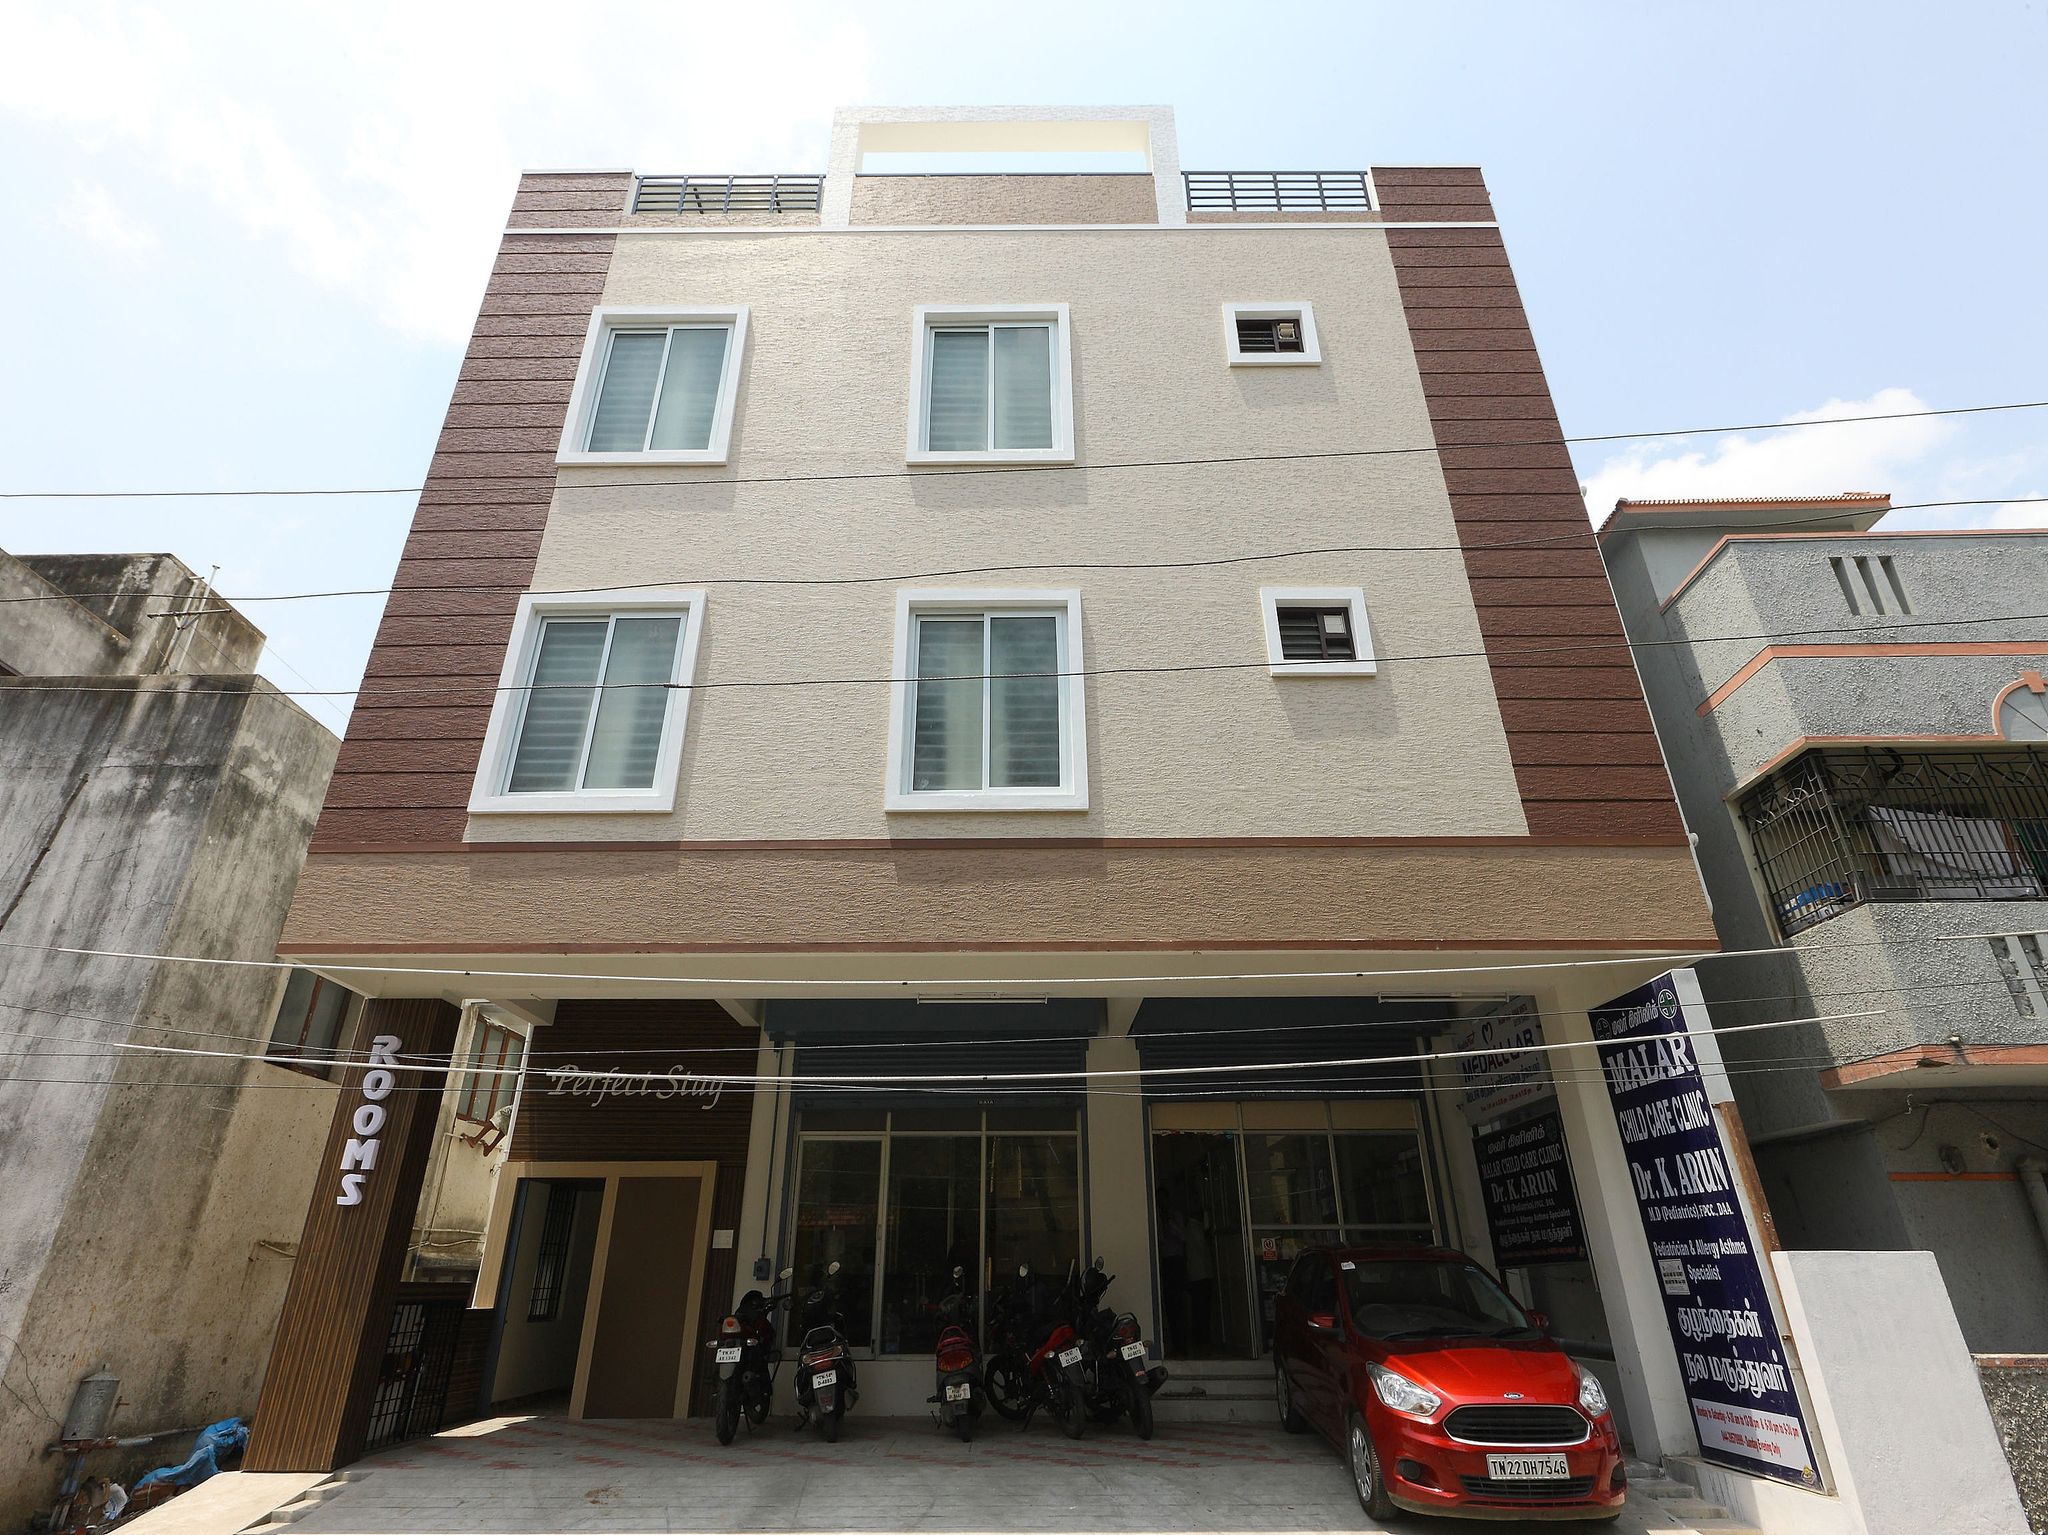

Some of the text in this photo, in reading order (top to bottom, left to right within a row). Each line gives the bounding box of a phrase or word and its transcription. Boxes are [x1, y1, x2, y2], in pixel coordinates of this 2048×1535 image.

[547, 1063, 724, 1110] Perfect Stay
[1607, 1031, 1695, 1095] MALAR
[336, 1035, 403, 1206] ROOMS
[1619, 1089, 1710, 1144] CHILD CARE CLINIC
[1501, 1155, 1521, 1175] CHILD
[1520, 1150, 1540, 1170] CARE
[1538, 1143, 1563, 1165] CLINIC
[1632, 1147, 1730, 1200] Dr. K. ARUN
[1490, 1182, 1508, 1203] Dr.
[1519, 1169, 1559, 1198] ARUN
[1653, 1237, 1748, 1260] Pediatrician & Allergy Asthma
[1686, 1263, 1722, 1285] Specialist
[1677, 1295, 1763, 1343] குழந்தைகள்
[1683, 1345, 1789, 1399] நல மருத்துவர்
